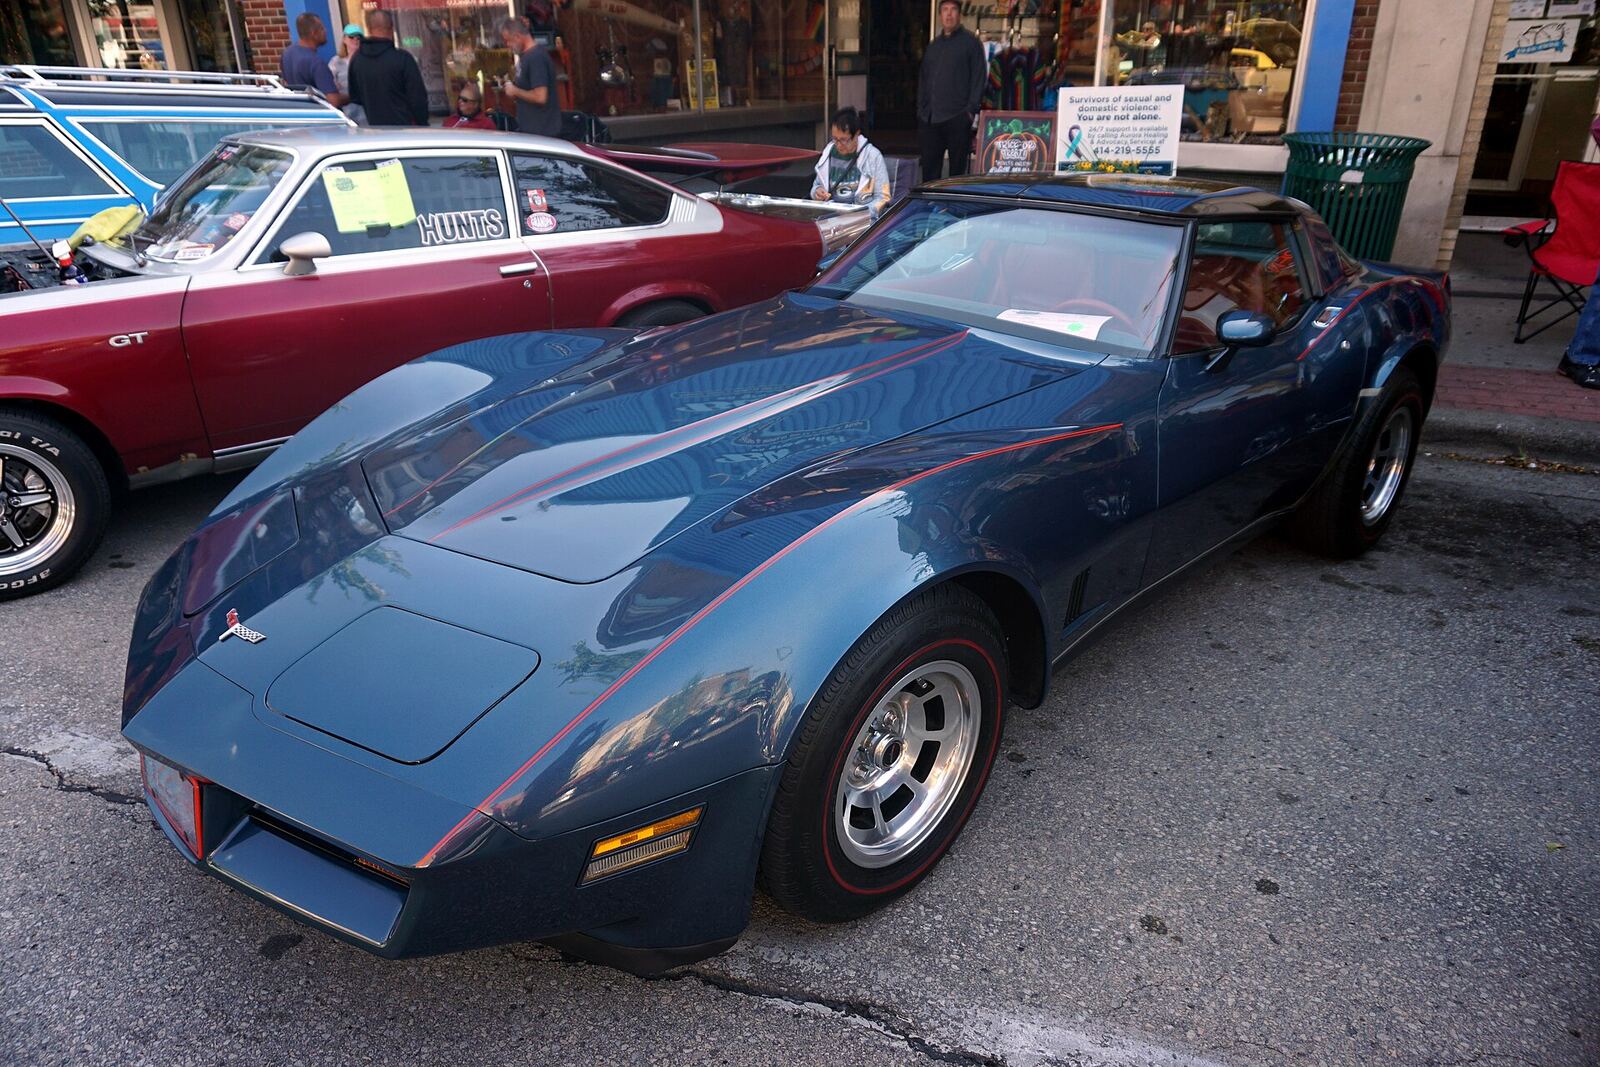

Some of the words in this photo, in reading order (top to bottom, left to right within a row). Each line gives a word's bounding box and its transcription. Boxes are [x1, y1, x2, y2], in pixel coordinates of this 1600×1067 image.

[1069, 95, 1110, 103] Survivors
[1112, 95, 1122, 103] of
[1124, 94, 1153, 103] sexual
[1154, 94, 1172, 102] and
[1078, 104, 1118, 112] domestic
[1121, 103, 1161, 111] violence:
[1113, 113, 1130, 121] not
[1132, 112, 1161, 120] alone.
[1093, 146, 1161, 155] 414-219-5555
[416, 208, 504, 245] HUNTS
[109, 331, 148, 347] GT
[31, 436, 60, 456] T/A
